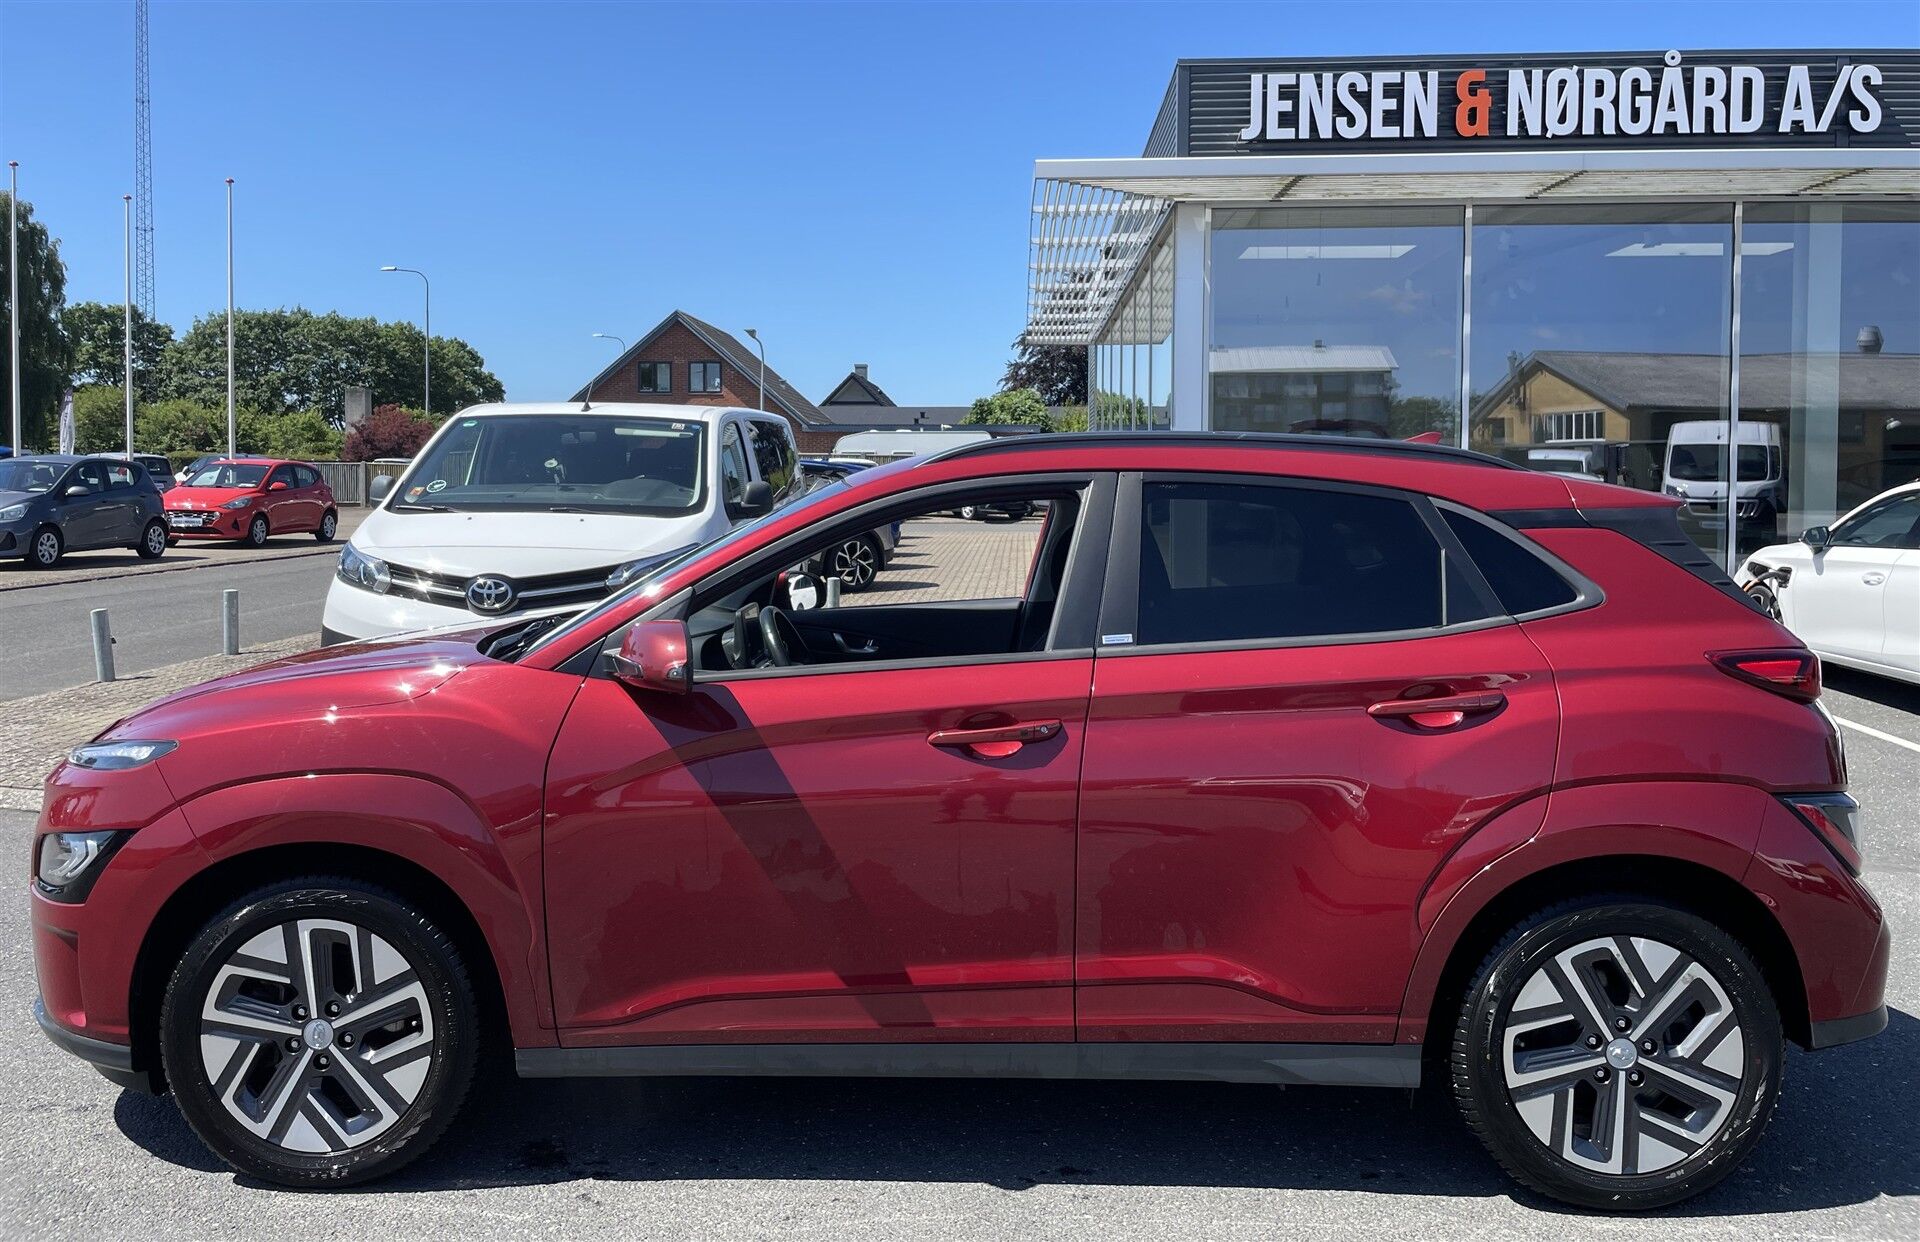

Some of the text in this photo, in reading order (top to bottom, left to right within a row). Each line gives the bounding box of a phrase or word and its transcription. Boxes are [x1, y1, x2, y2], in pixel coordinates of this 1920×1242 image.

[1240, 49, 1883, 140] JENSEN & NØRGÅRD A/S
